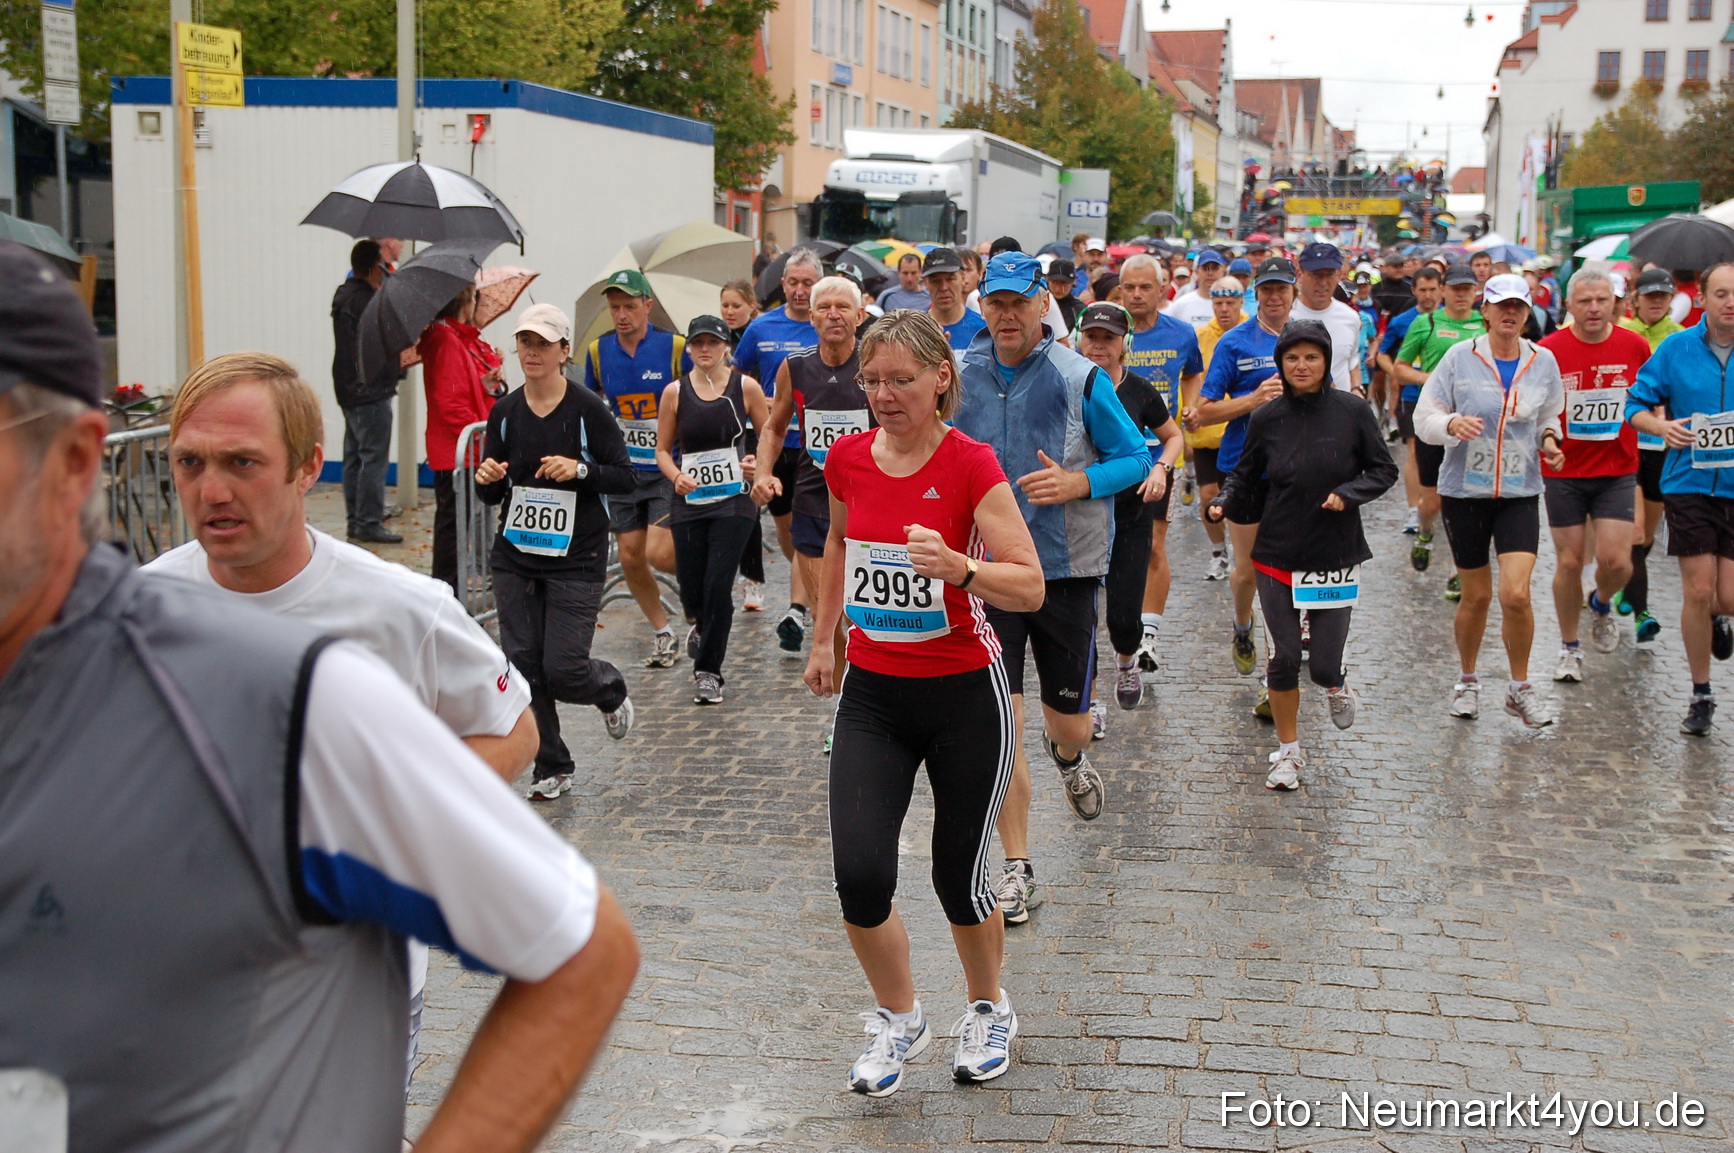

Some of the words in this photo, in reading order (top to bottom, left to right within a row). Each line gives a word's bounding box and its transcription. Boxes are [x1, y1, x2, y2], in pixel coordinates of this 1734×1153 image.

[190, 28, 224, 45] Kinder-
[183, 46, 231, 68] betreuung
[856, 171, 917, 185] BOCK
[1068, 199, 1109, 218] BO
[1322, 202, 1361, 212] START
[1124, 350, 1178, 359] EUMARKTER
[1123, 359, 1167, 367] TADTLAUF
[1573, 402, 1620, 422] 2707
[688, 462, 734, 486] 2861
[701, 488, 728, 497] Sabine
[512, 504, 567, 532] 2860
[520, 534, 553, 546] Martina
[870, 549, 908, 561] BOCK
[854, 567, 933, 609] 2993
[1317, 590, 1341, 600] Erika
[863, 612, 924, 629] Waltraud
